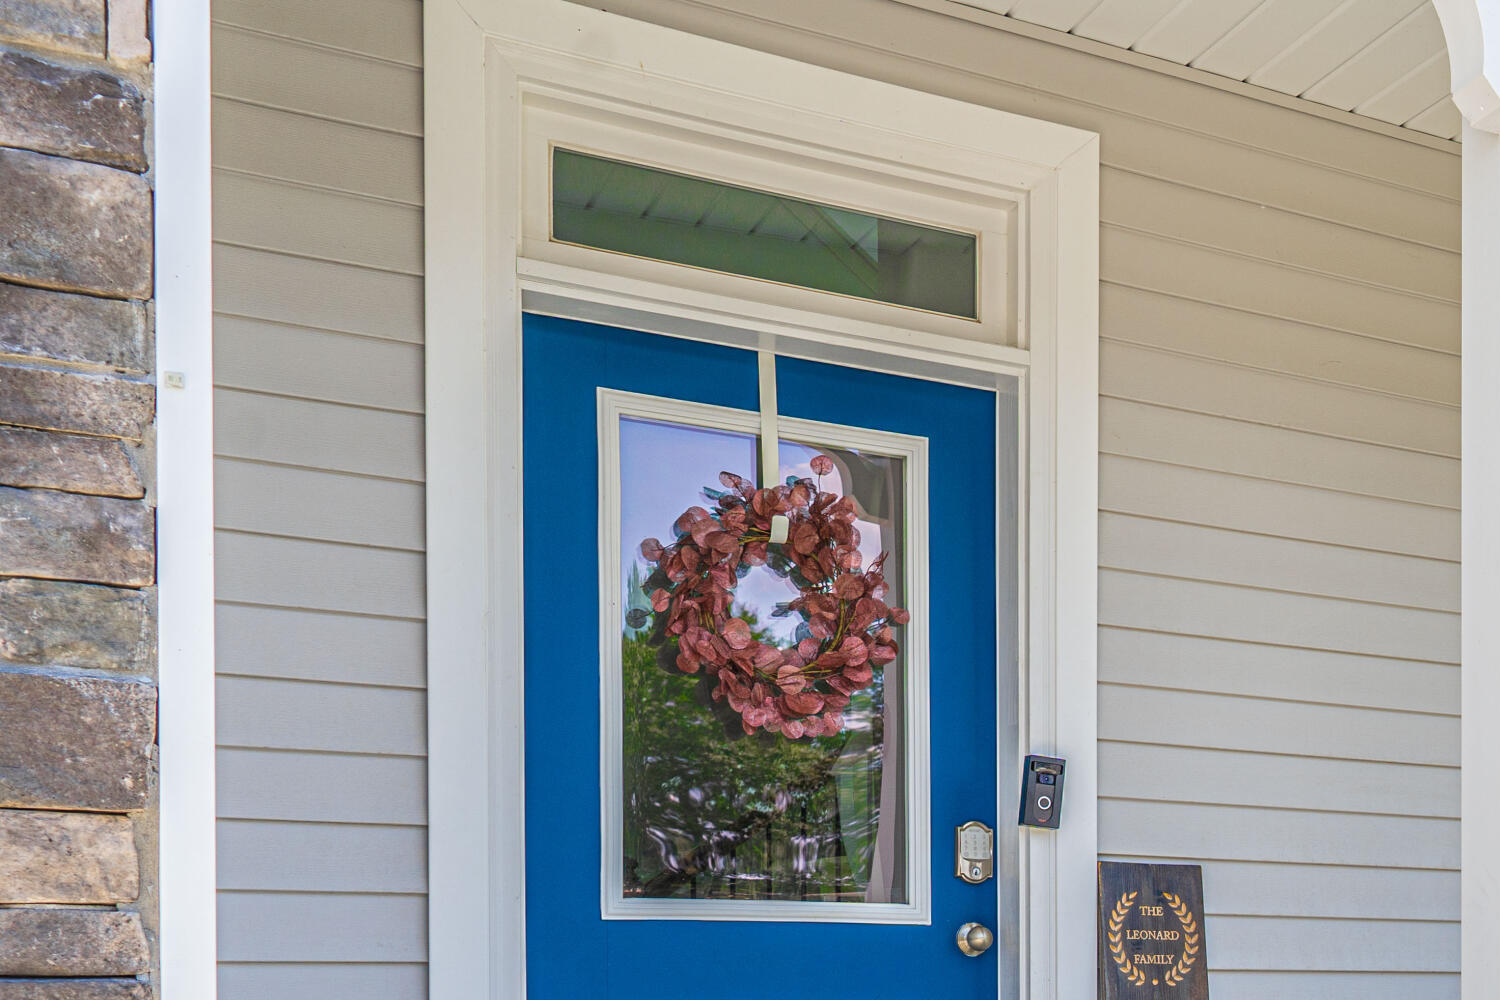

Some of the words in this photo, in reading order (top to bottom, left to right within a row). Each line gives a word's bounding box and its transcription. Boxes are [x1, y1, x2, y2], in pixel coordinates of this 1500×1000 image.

[1139, 905, 1164, 917] THE
[1125, 929, 1180, 941] LEONARD
[1133, 953, 1175, 965] FAMILY
